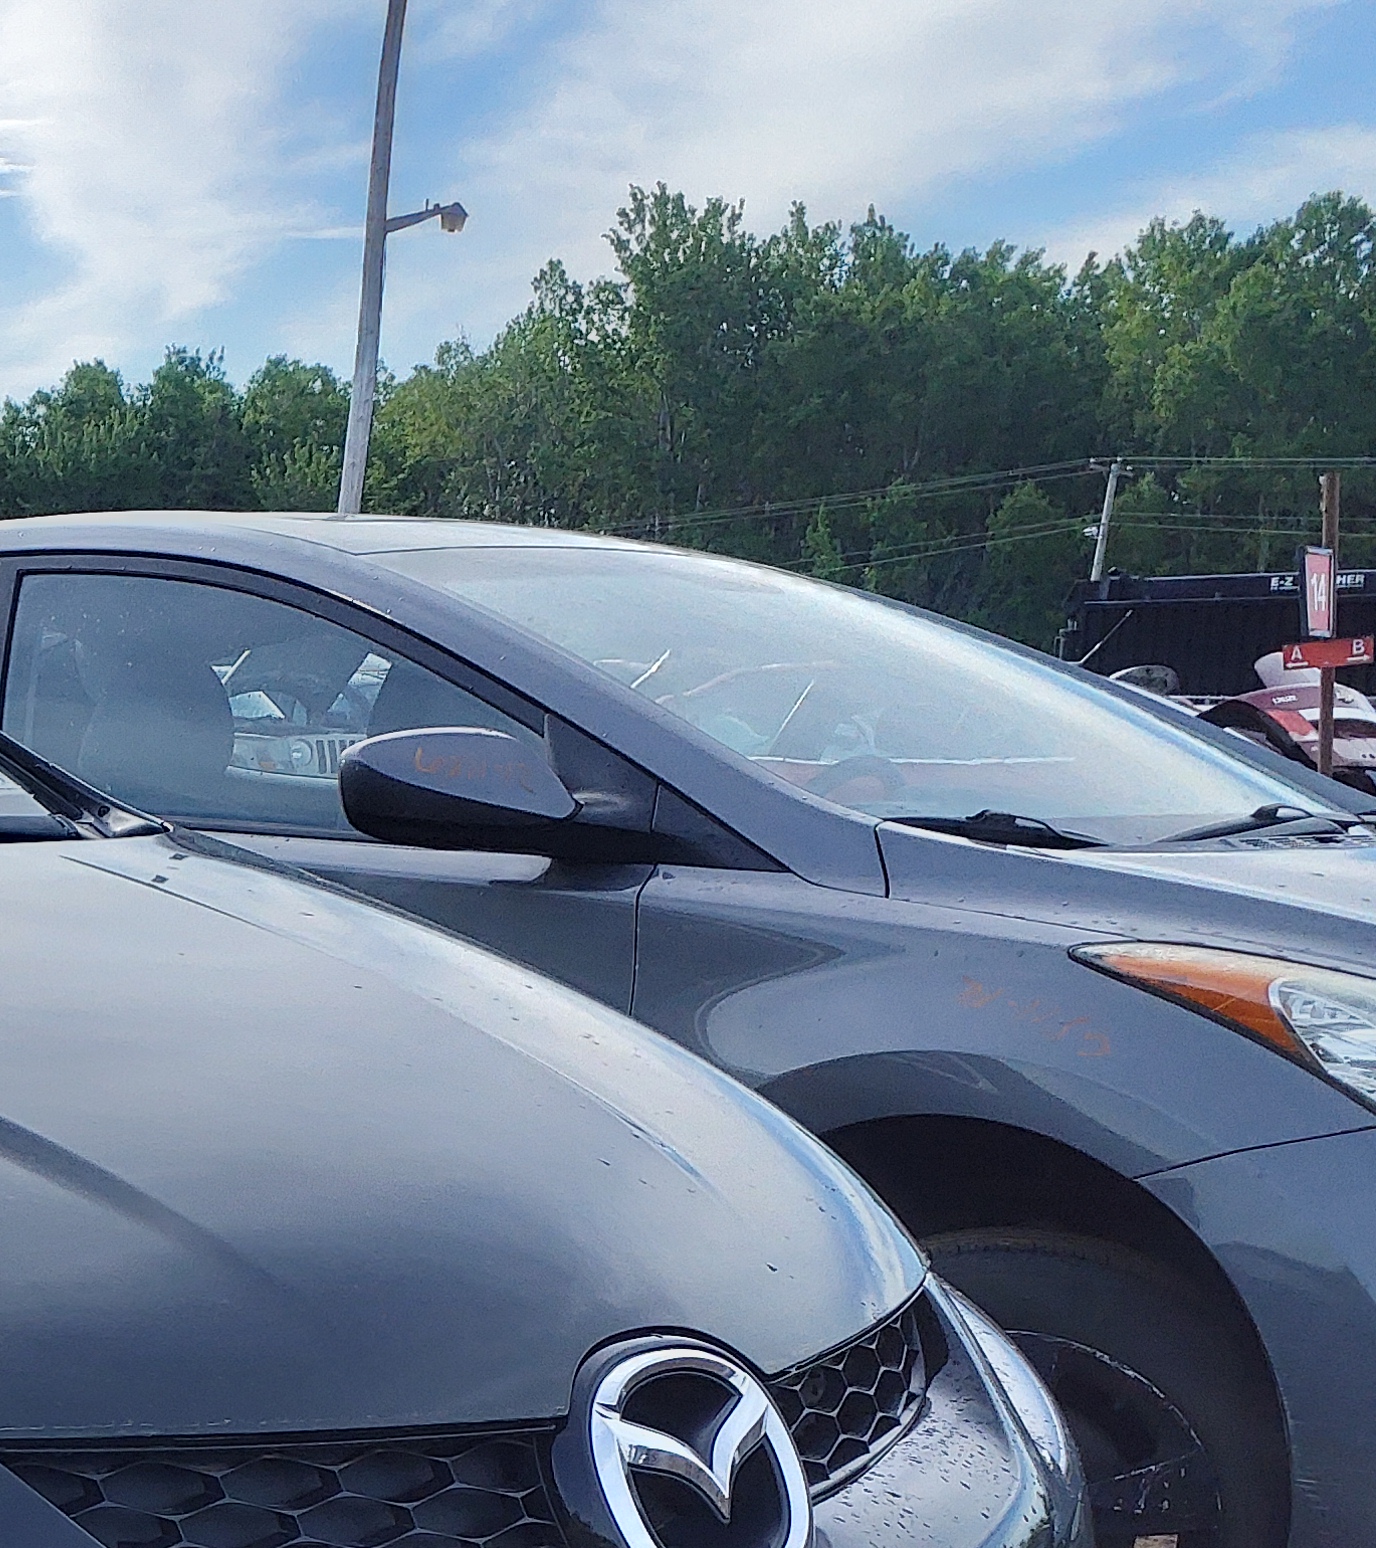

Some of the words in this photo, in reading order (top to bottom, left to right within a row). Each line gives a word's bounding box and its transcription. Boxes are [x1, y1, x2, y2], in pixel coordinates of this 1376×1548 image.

[1311, 572, 1326, 611] 14
[1291, 645, 1303, 660] A
[1352, 638, 1365, 655] B
